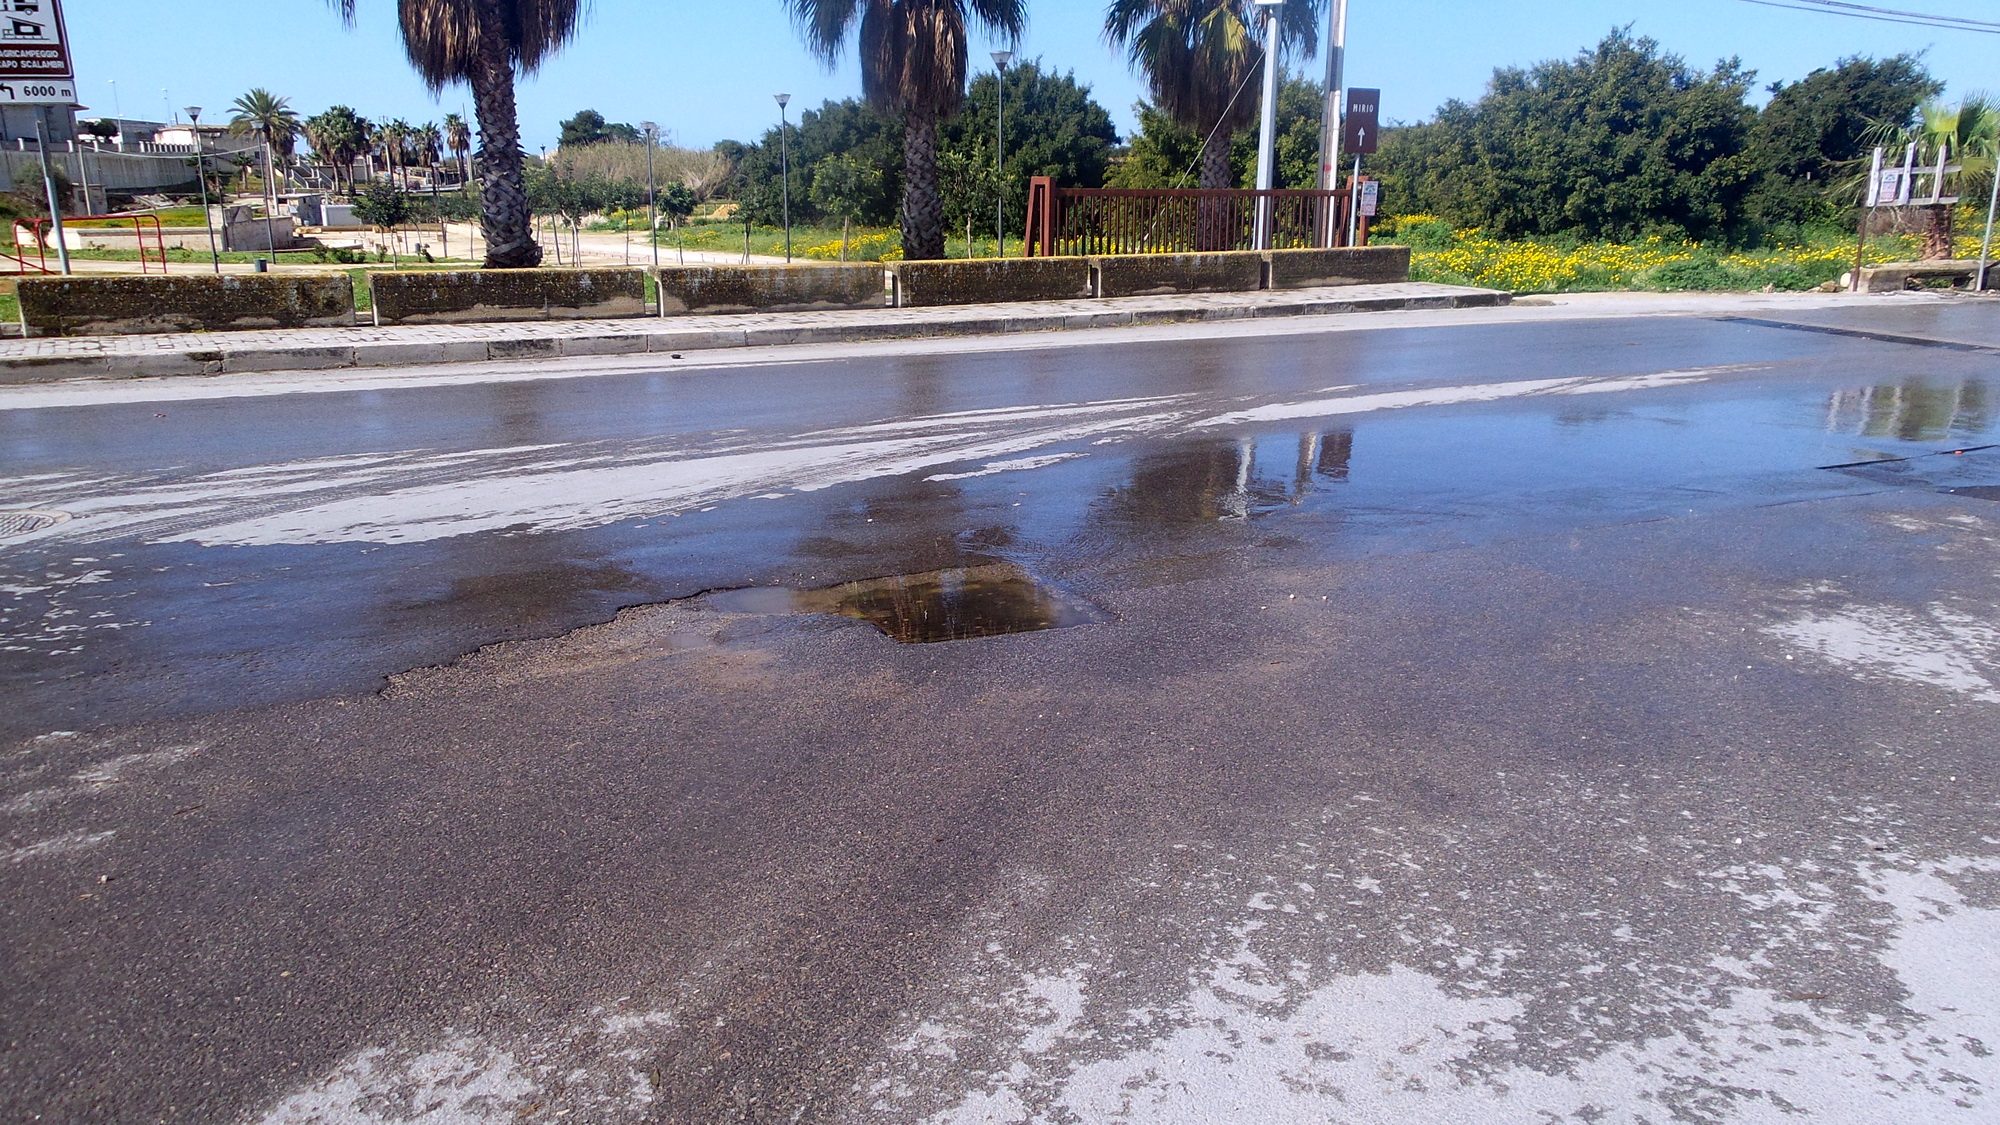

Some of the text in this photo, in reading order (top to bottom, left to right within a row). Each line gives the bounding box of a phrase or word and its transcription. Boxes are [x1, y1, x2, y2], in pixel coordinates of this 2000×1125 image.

[21, 60, 65, 69] SCALAMBRI
[23, 86, 72, 97] 6000 m
[1352, 103, 1374, 113] MIRIO
